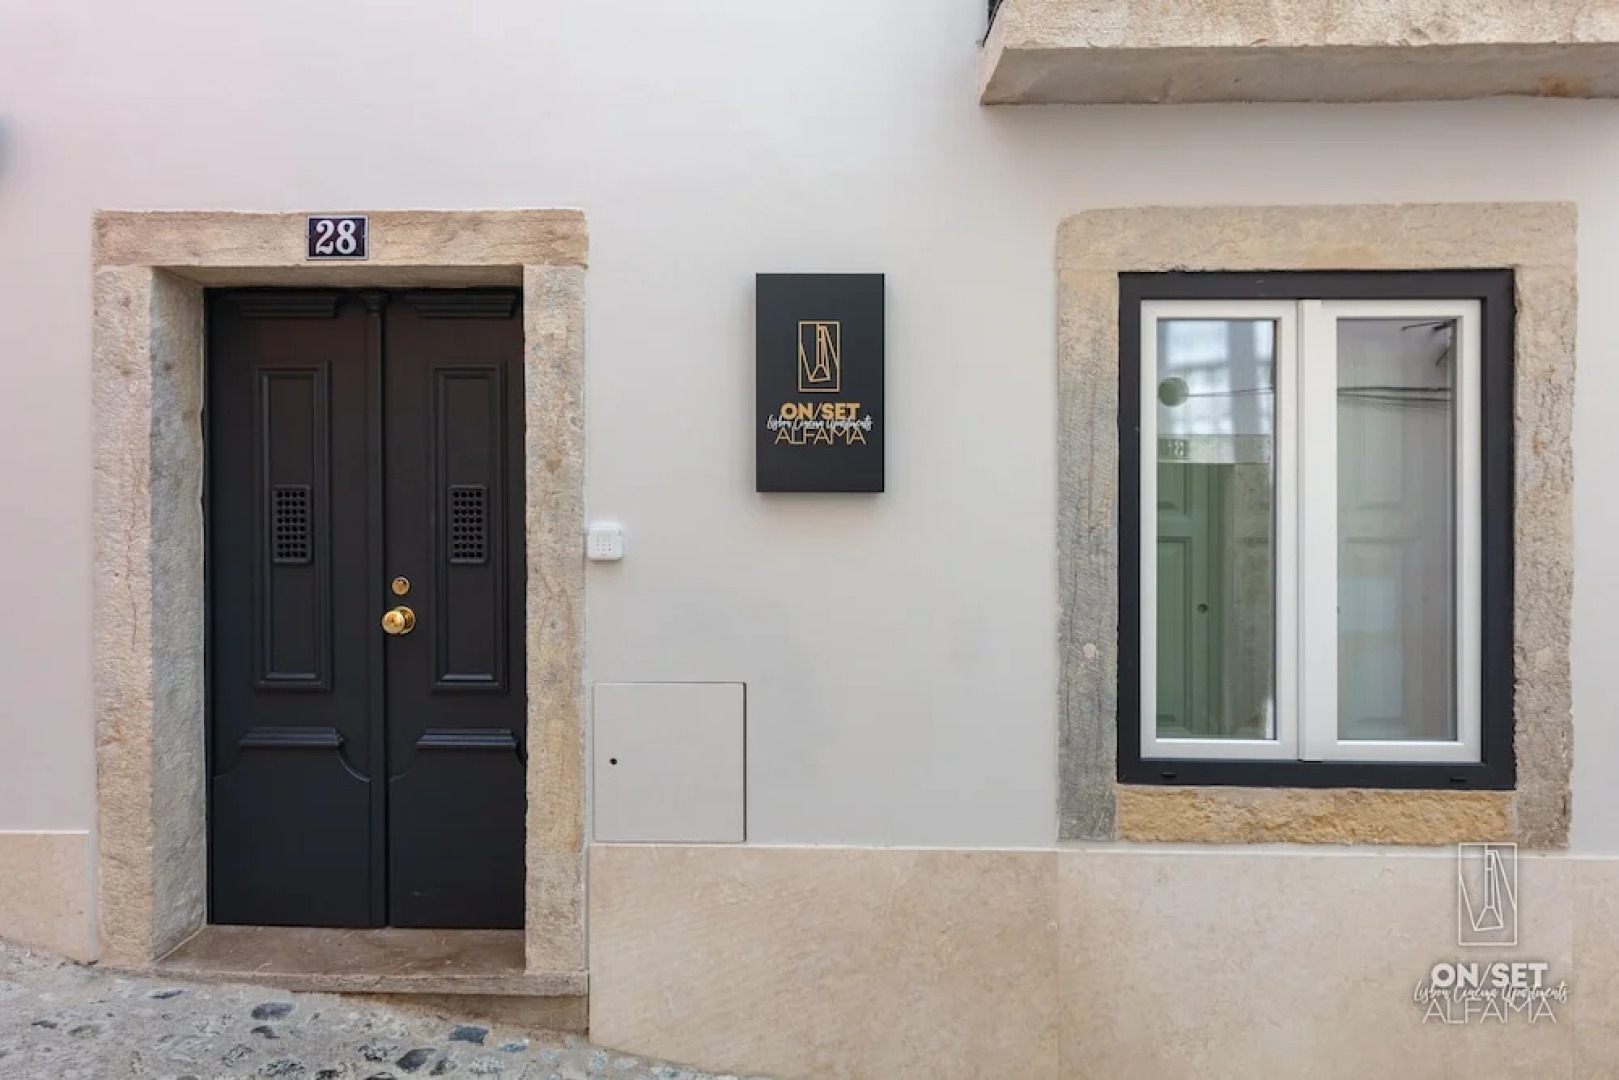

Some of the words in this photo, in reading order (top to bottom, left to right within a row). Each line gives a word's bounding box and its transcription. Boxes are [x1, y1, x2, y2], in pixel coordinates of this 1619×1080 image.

[315, 219, 357, 255] 28
[781, 402, 861, 420] ON/SET
[774, 425, 867, 445] ALFAMA
